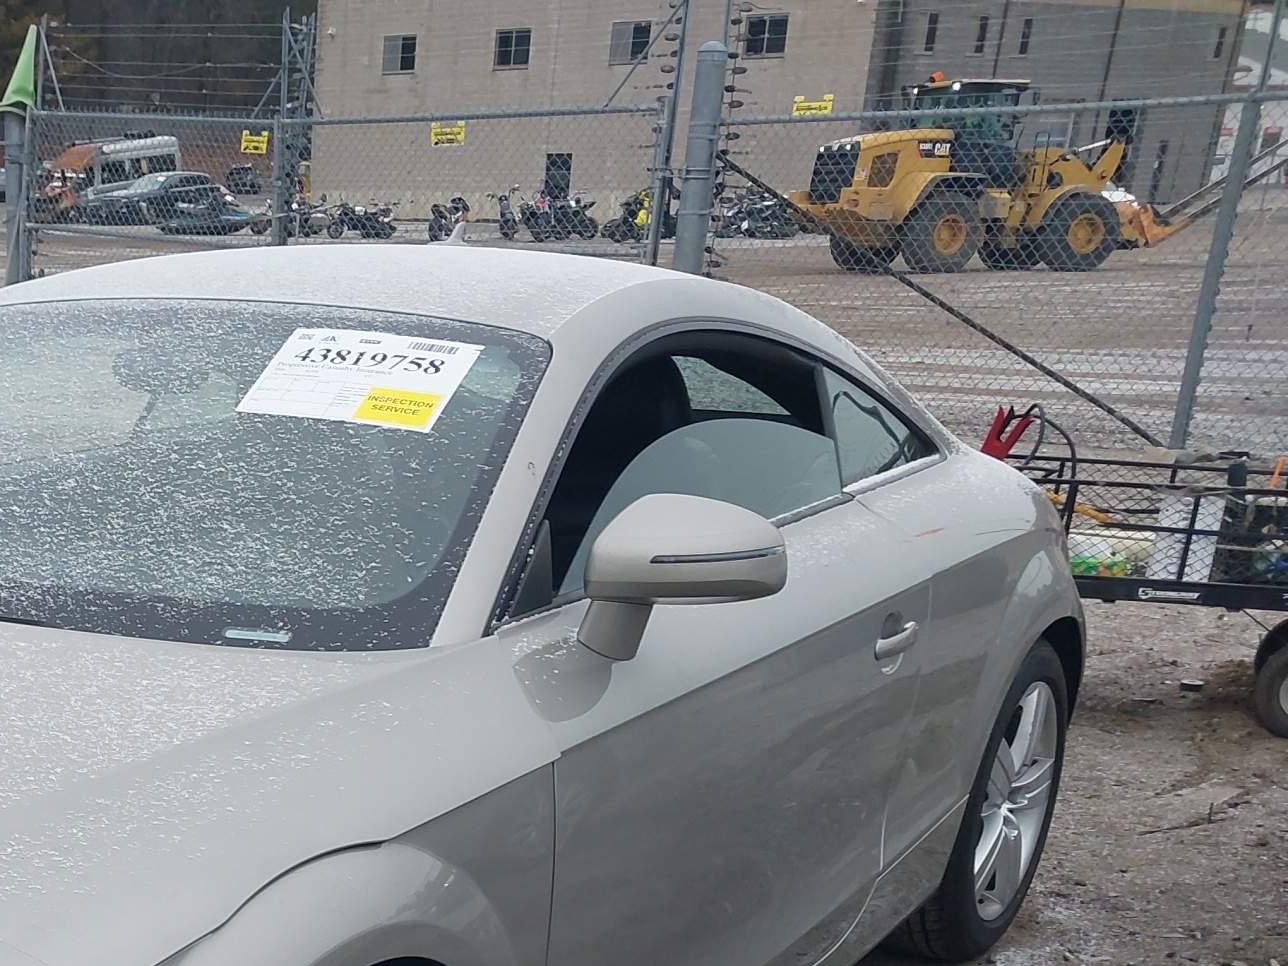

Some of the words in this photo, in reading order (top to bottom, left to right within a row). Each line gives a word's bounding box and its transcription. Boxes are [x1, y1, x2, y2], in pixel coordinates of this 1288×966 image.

[935, 143, 951, 155] CAT
[294, 347, 445, 374] 43819758
[367, 395, 434, 408] INSPECTION
[370, 404, 422, 415] SERVICE
